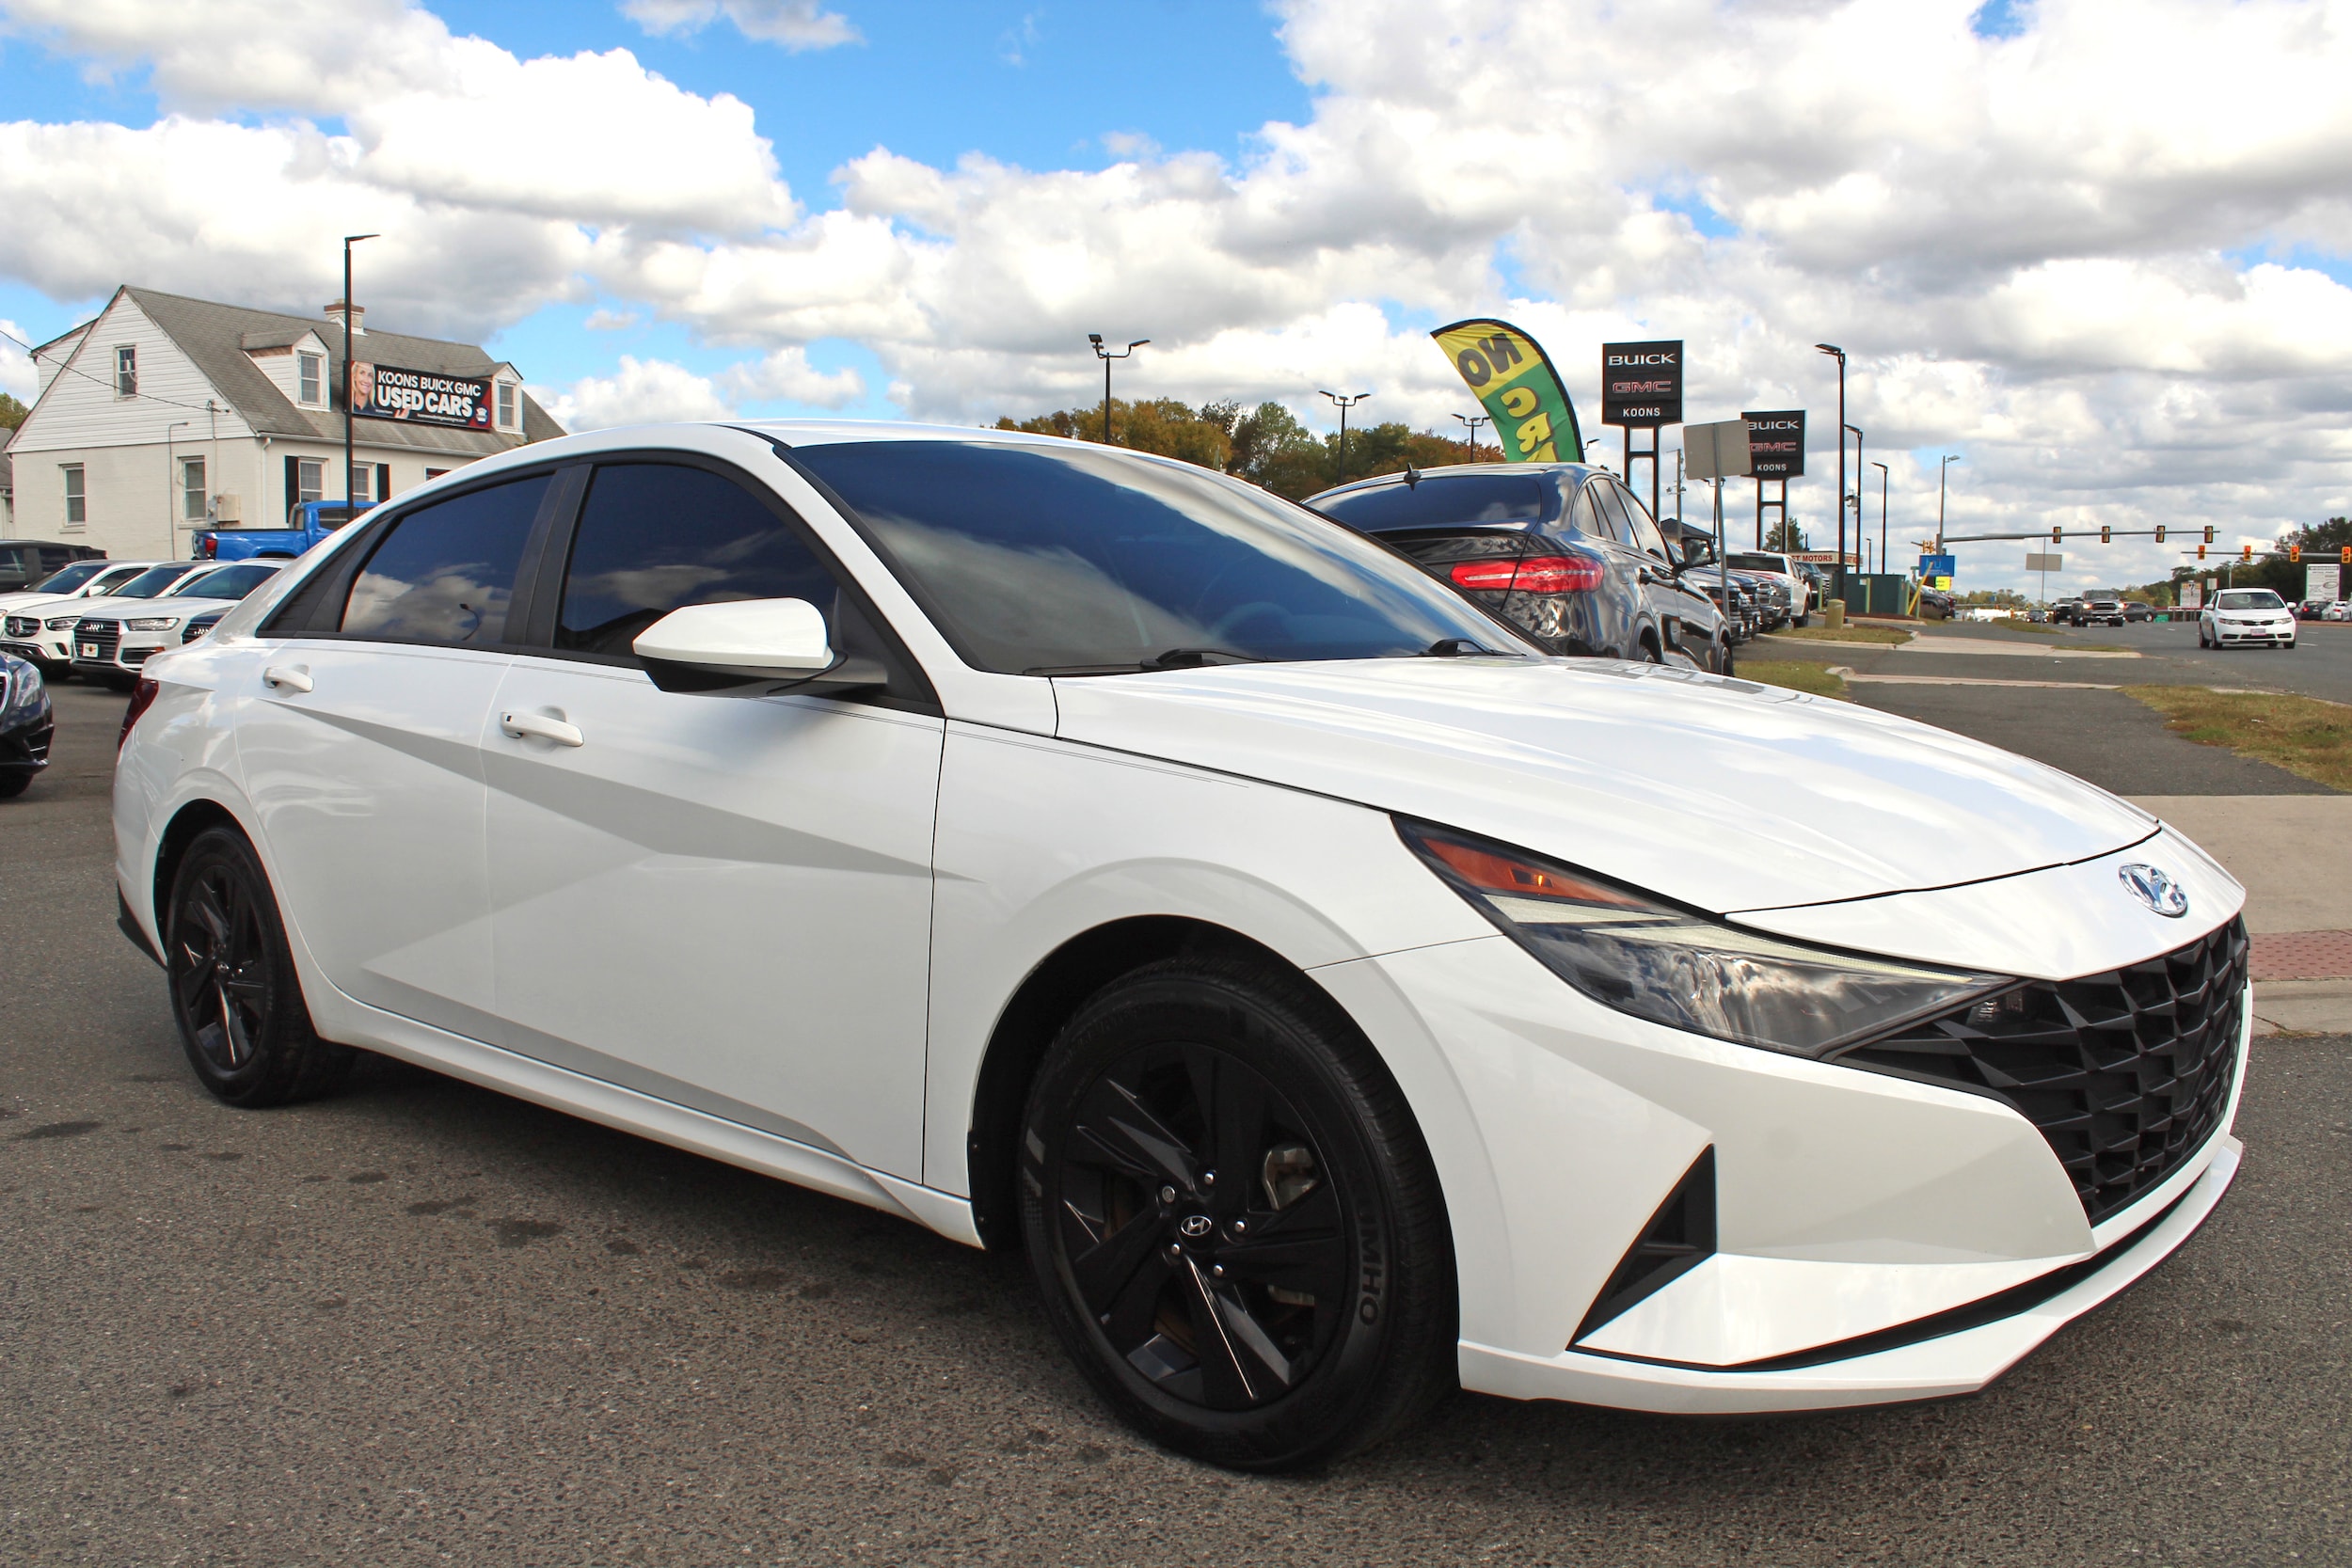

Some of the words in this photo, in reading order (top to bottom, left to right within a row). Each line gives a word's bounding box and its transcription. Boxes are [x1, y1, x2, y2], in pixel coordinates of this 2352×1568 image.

[1608, 353, 1677, 366] BUICK
[377, 371, 419, 388] KOONS
[420, 376, 453, 393] BUICK
[454, 381, 482, 397] GMC
[1612, 380, 1672, 393] GMC
[377, 386, 424, 410] USED
[425, 391, 473, 418] CARS
[1622, 406, 1661, 418] KOONS
[1747, 420, 1800, 431] BUICK
[1749, 441, 1797, 451] GMC
[1756, 463, 1788, 471] KOONS
[1803, 554, 1833, 562] MOTORS
